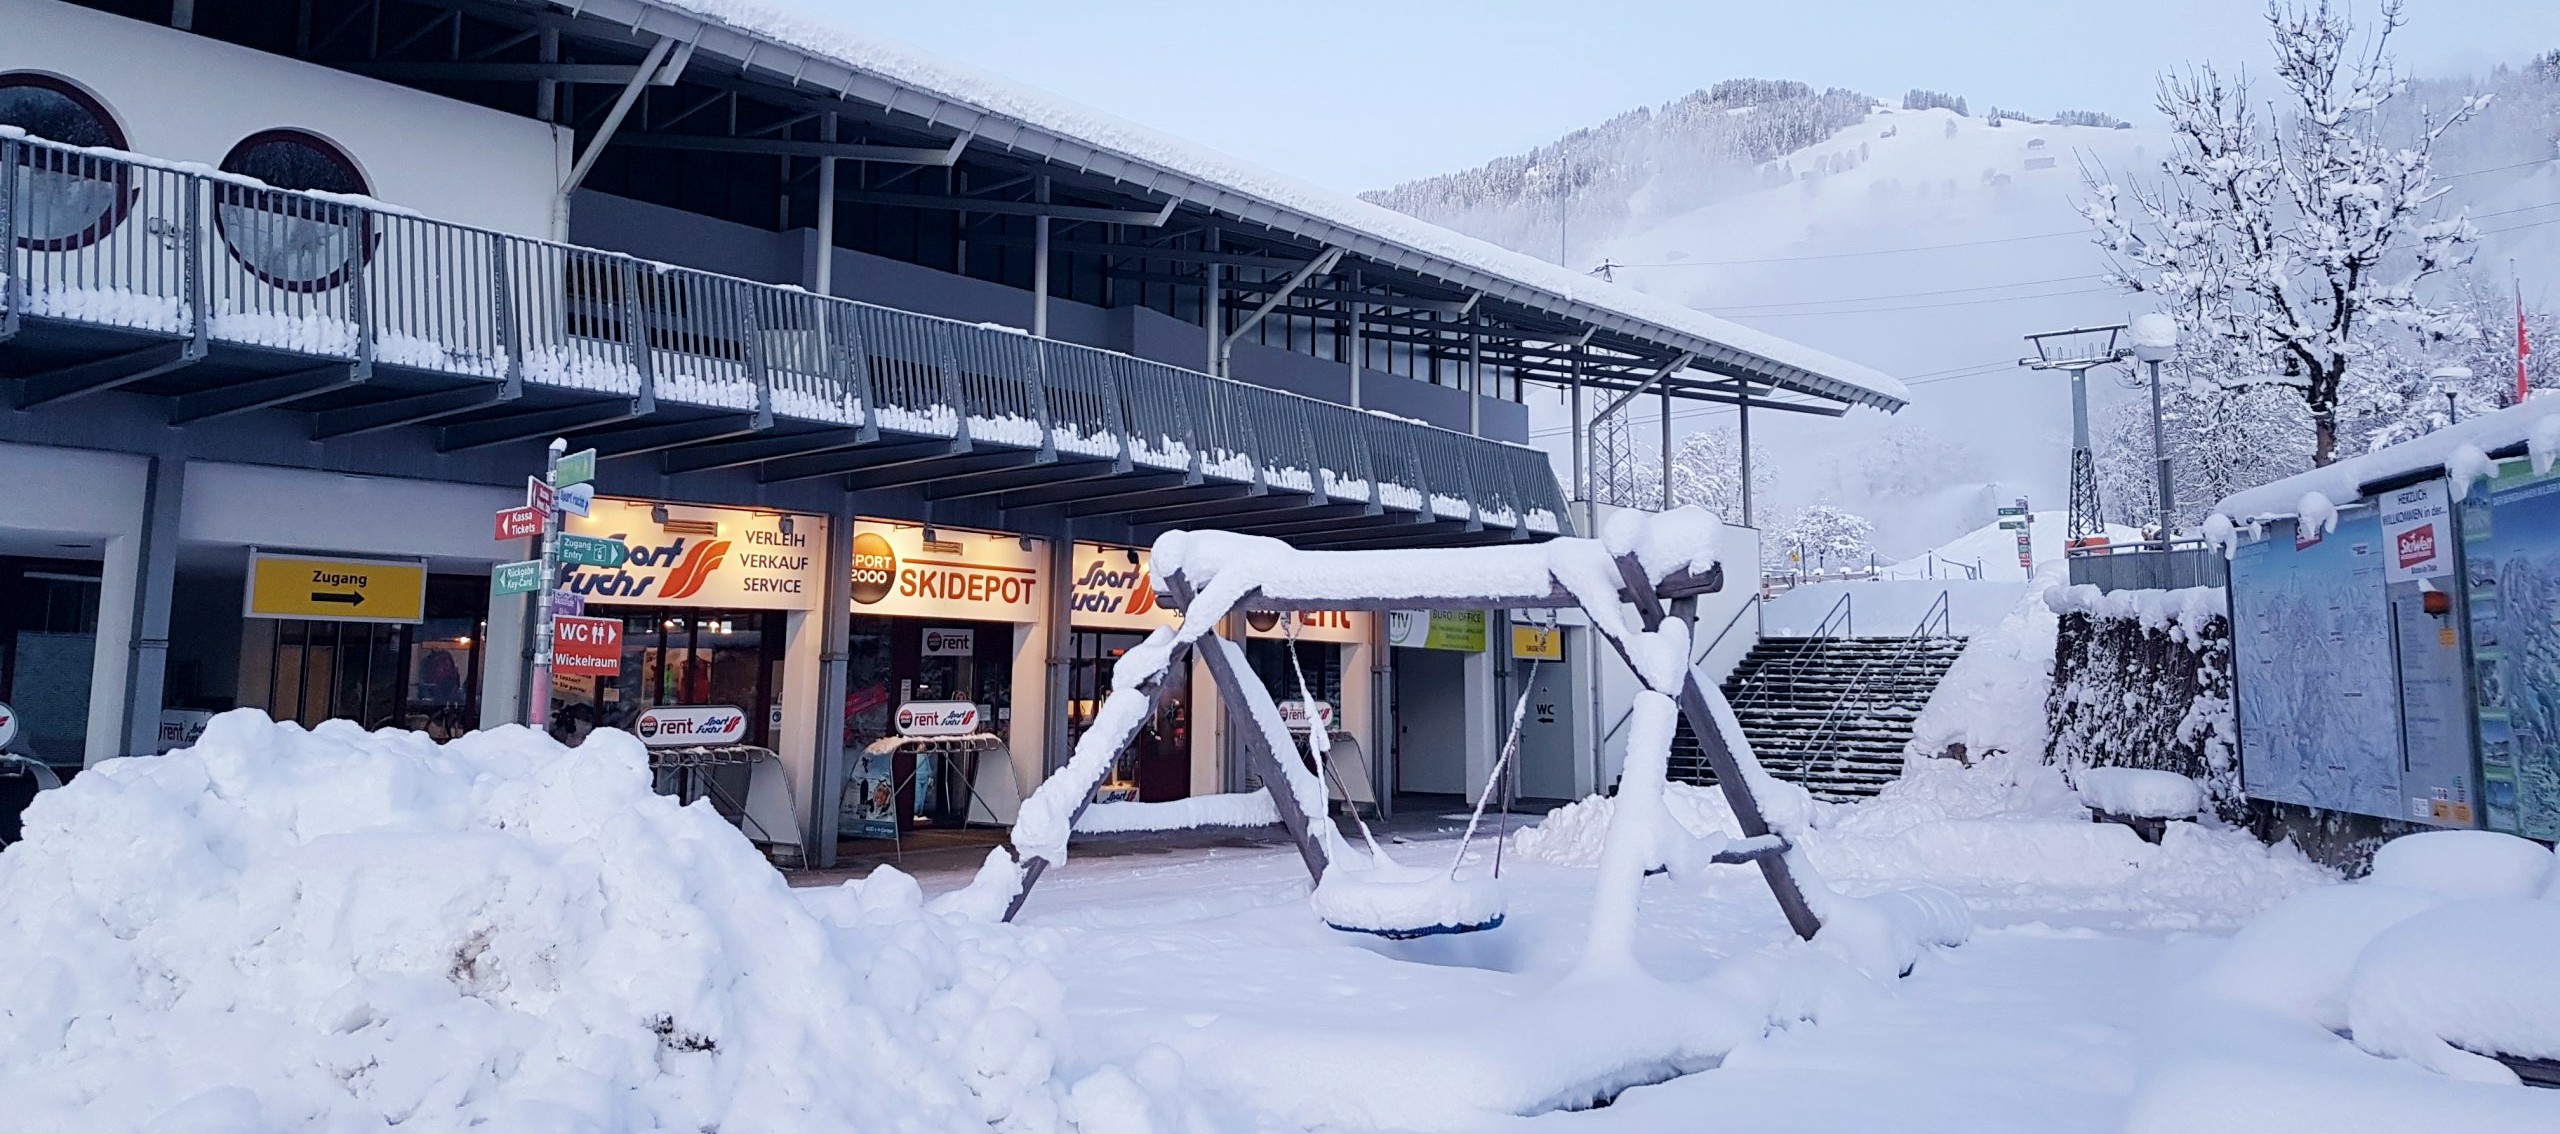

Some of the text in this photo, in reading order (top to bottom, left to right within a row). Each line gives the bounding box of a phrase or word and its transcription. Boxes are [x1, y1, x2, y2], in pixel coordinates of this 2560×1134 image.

[2398, 488, 2427, 505] HERZLICH
[512, 511, 533, 522] Kassa
[2383, 508, 2423, 526] WILLKOMMEN
[2424, 506, 2431, 517] in
[512, 523, 535, 535] Tickets
[564, 538, 592, 550] Zugang
[745, 530, 806, 548] VERLEIH
[564, 549, 583, 561] Entry
[740, 553, 808, 571] VERKAUF
[312, 570, 368, 588] Zugang
[508, 567, 534, 578] Rückgabe
[1077, 561, 1141, 589] Sport
[507, 577, 532, 589] Key-Card
[743, 577, 802, 594] SERVICE
[900, 568, 1036, 604] SKIDEPOT
[560, 622, 588, 641] WC
[942, 635, 970, 649] rent
[555, 652, 617, 668] Wickelraum
[947, 710, 966, 719] Sport
[1536, 704, 1554, 715] WC
[660, 718, 693, 734] rent
[704, 716, 730, 726] Sport
[914, 711, 938, 726] rent
[163, 722, 184, 742] rent
